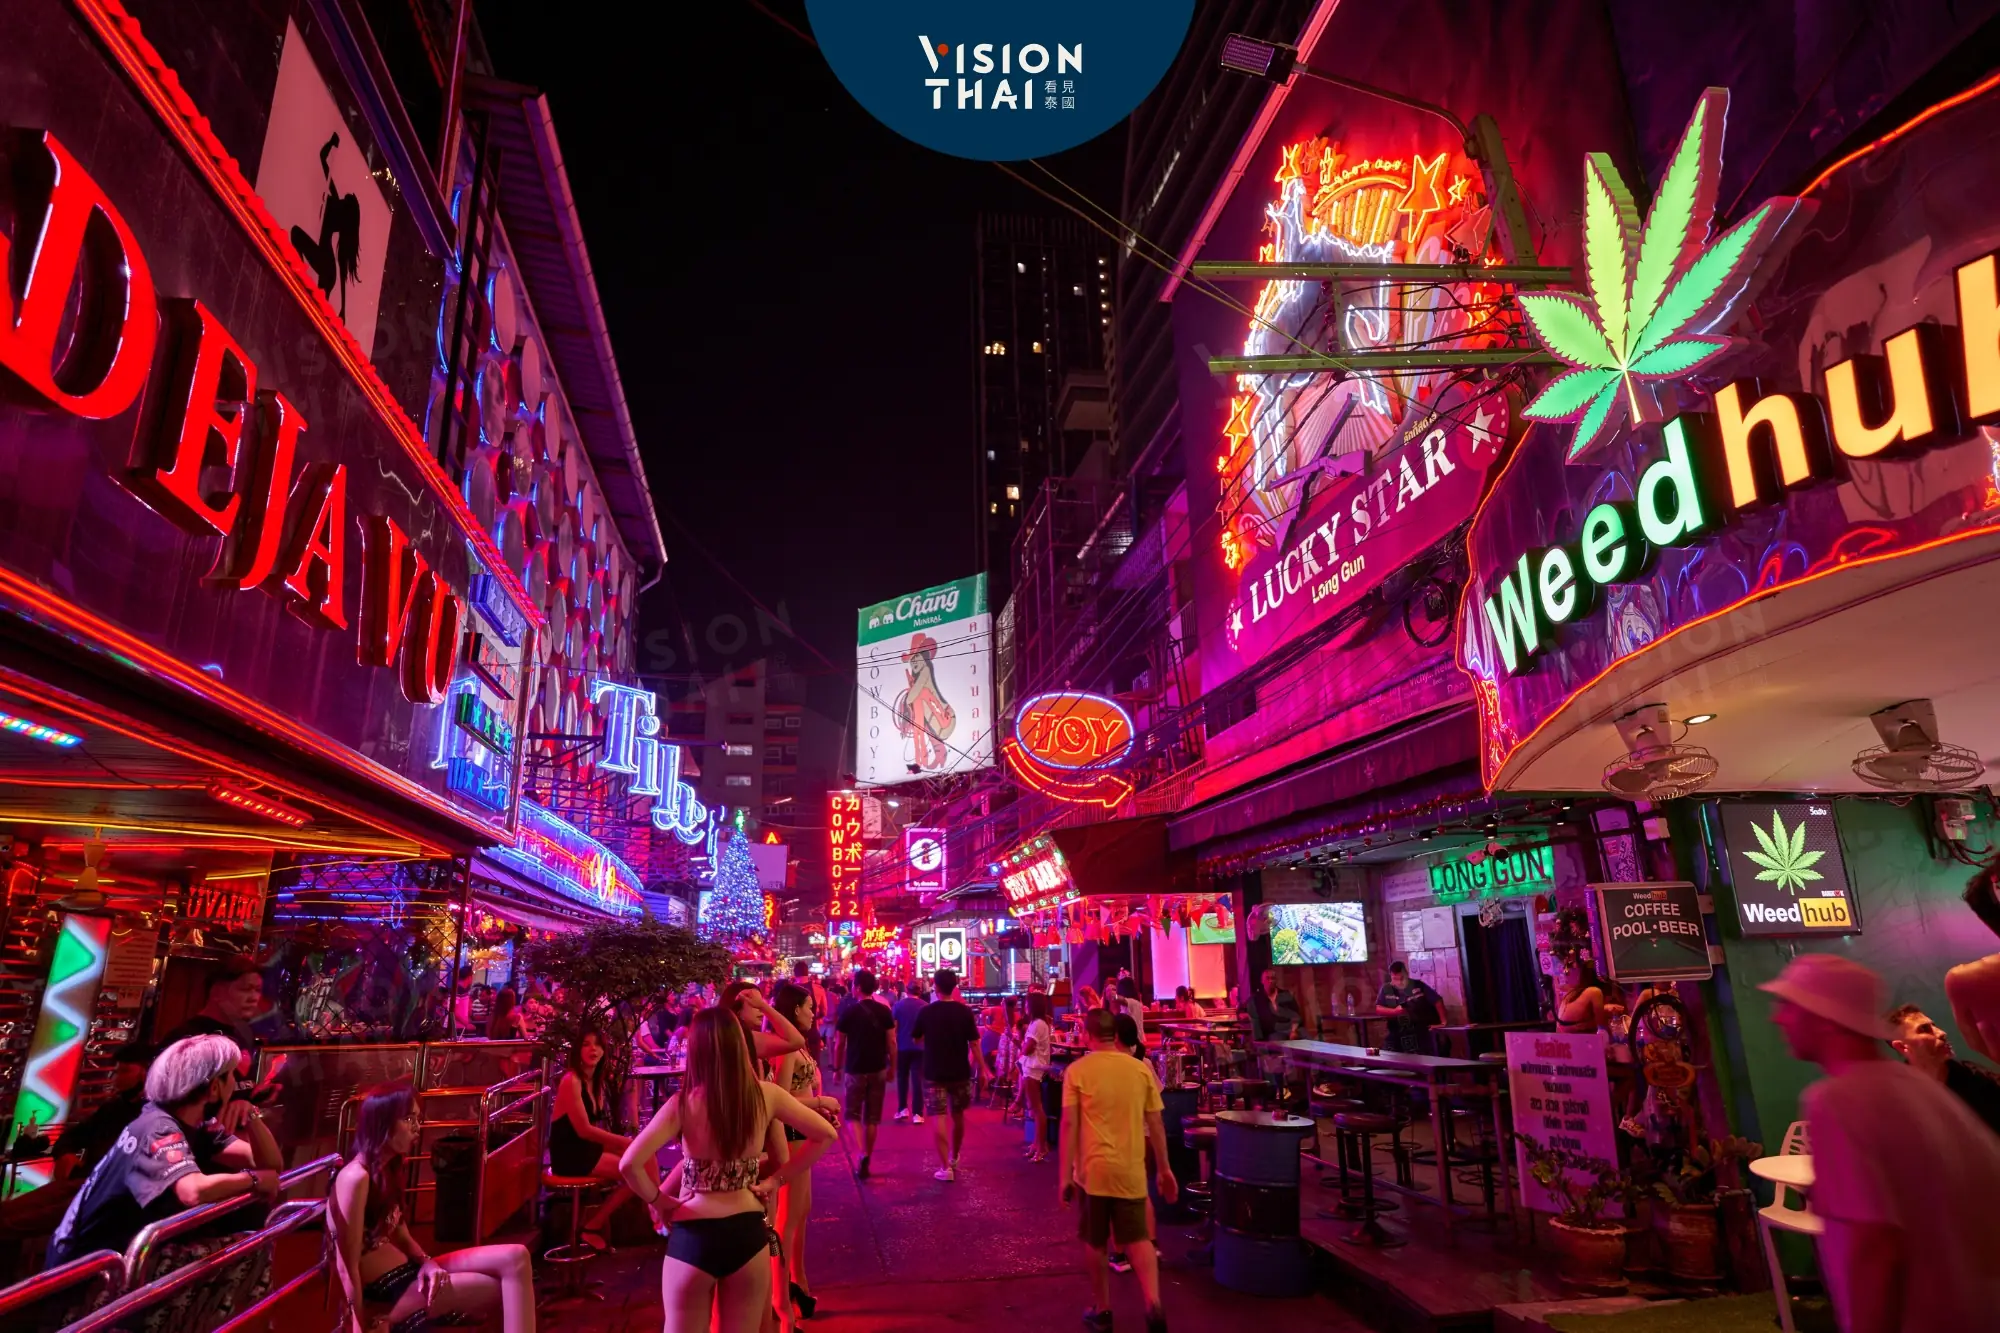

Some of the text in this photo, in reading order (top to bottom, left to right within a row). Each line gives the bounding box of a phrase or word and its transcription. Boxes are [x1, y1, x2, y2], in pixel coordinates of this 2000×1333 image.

[1250, 428, 1456, 624] LUCKY STAR
[1311, 554, 1365, 604] Long Gun
[896, 588, 960, 621] Chang
[1030, 712, 1124, 757] TOY
[831, 796, 845, 916] COWBOY2
[1429, 860, 1488, 894] LONG
[1493, 845, 1547, 885] GUN
[1613, 920, 1700, 940] POOL BEER
[1624, 903, 1681, 918] COFFEE
